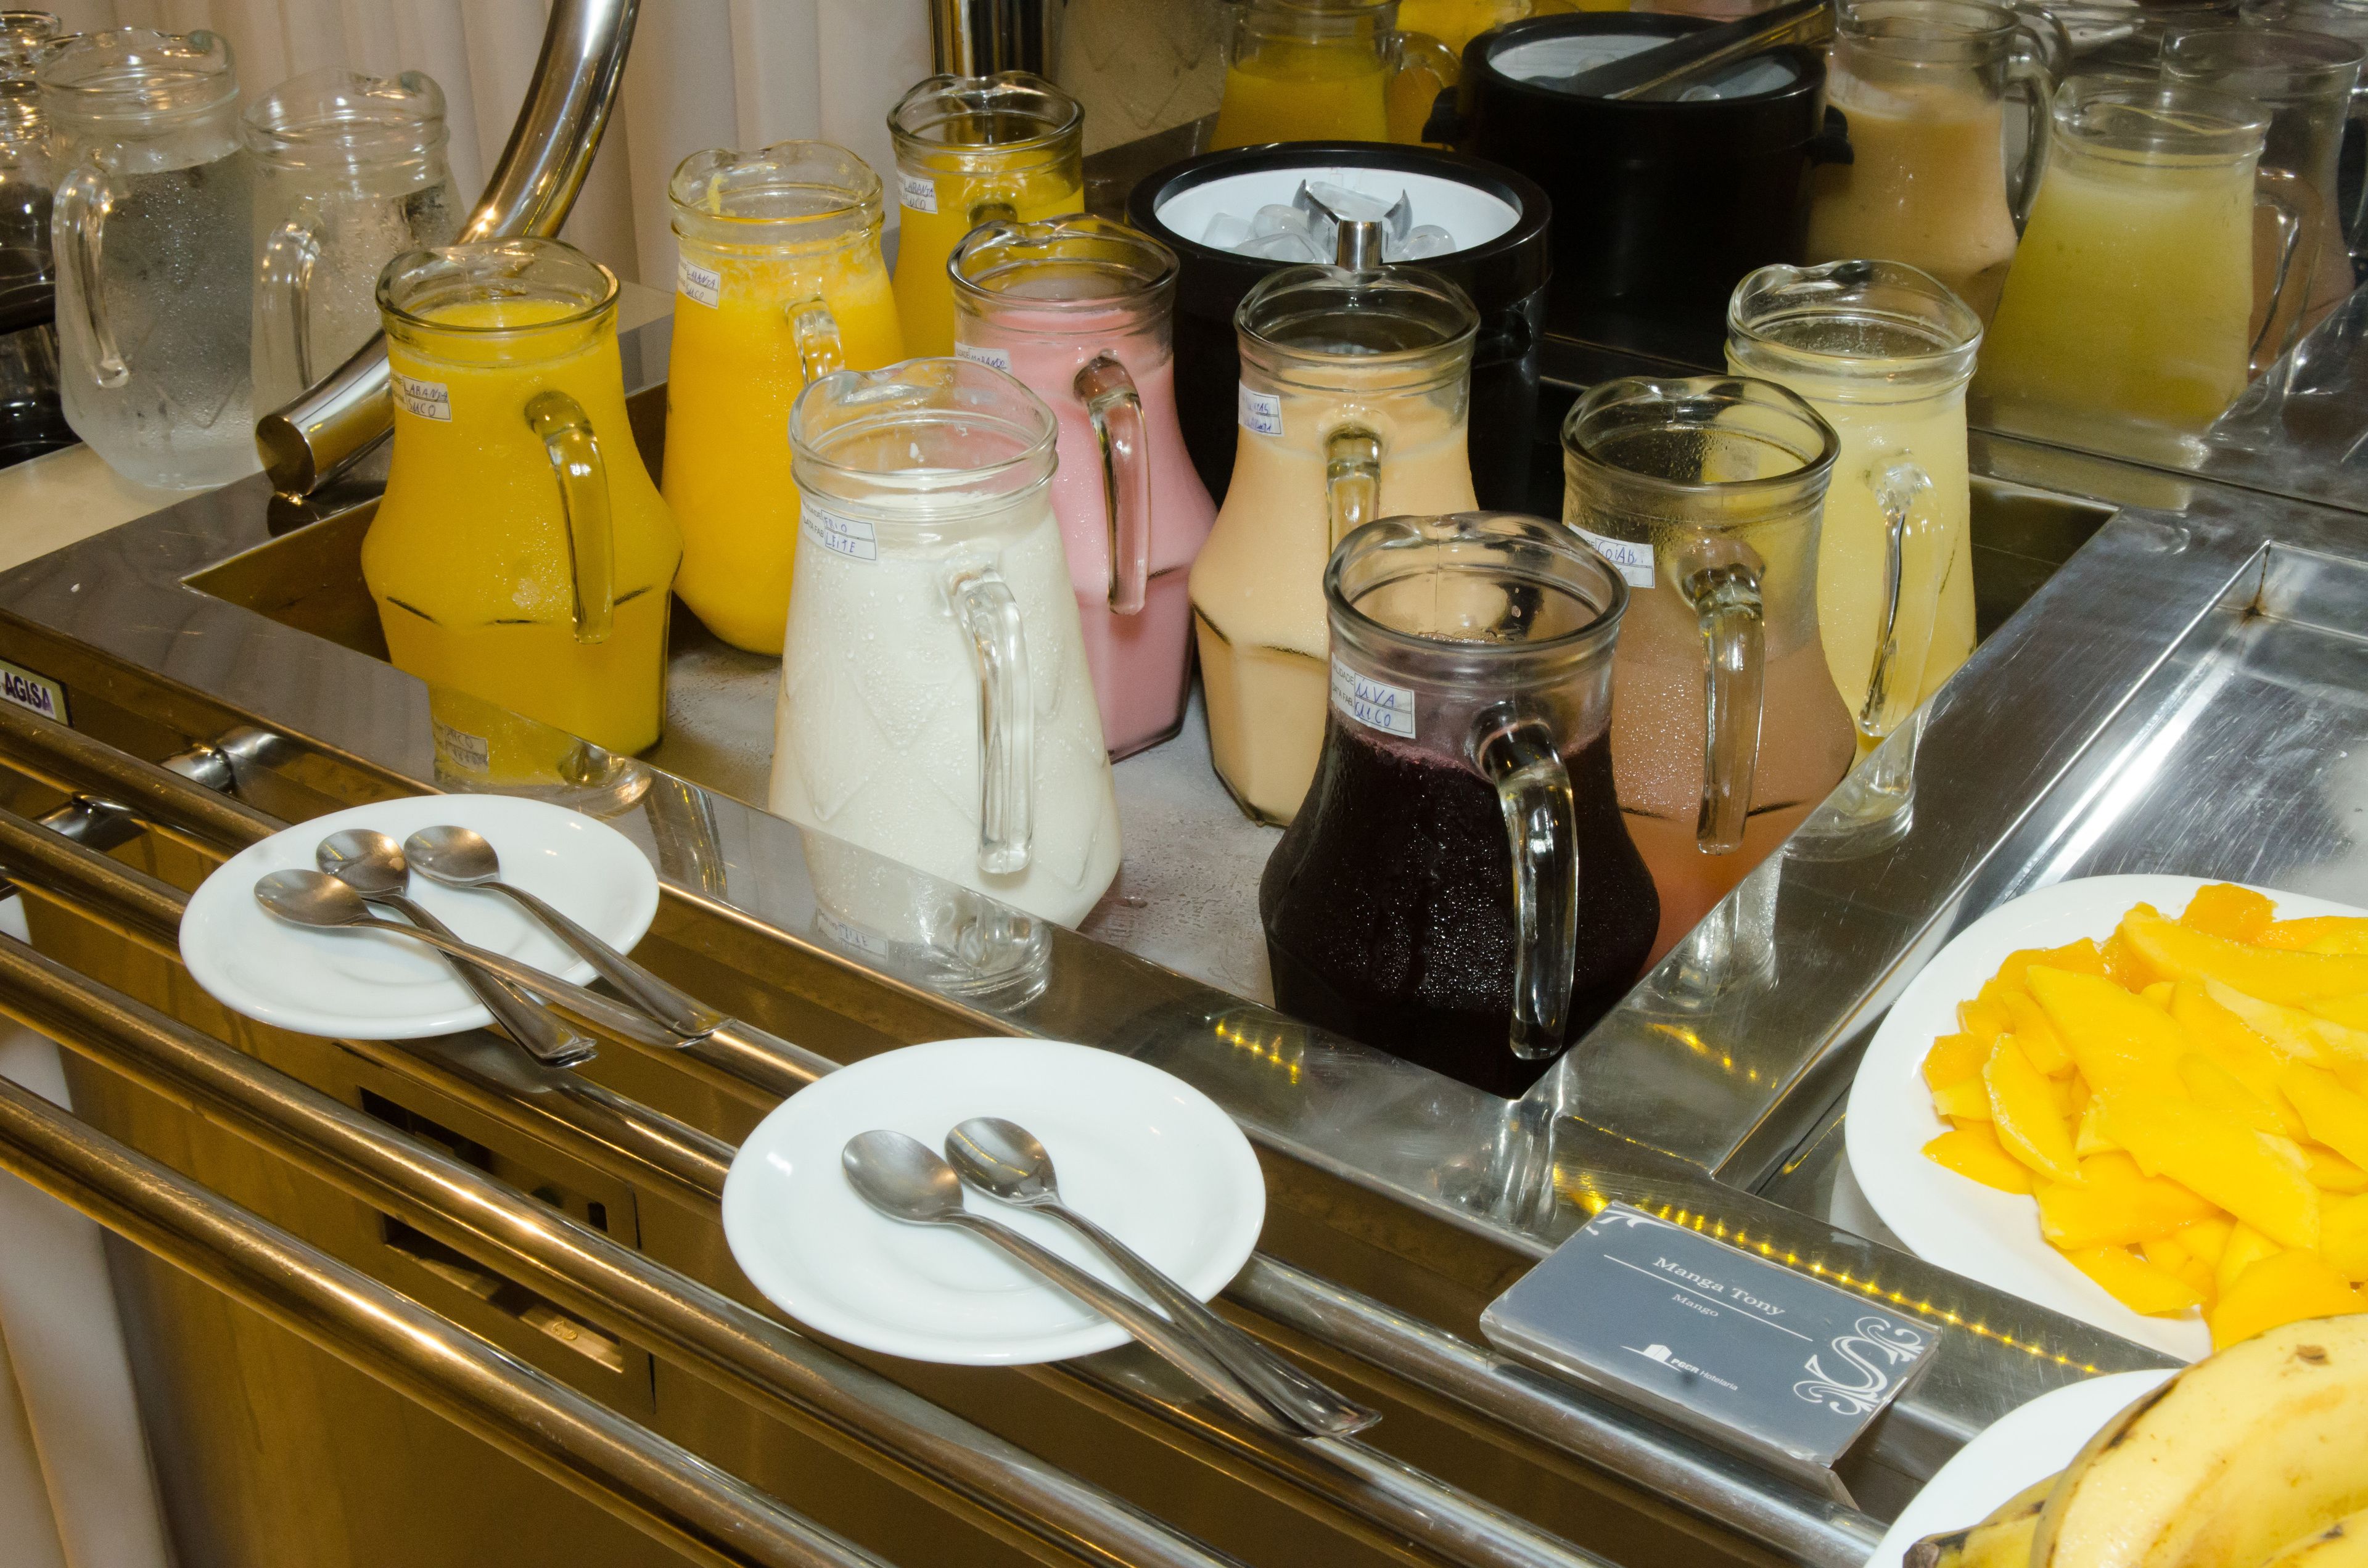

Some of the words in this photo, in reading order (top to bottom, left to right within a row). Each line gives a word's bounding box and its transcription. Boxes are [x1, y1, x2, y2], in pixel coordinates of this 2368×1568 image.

[826, 532, 856, 553] LEITE
[5, 671, 54, 715] AGISA
[1653, 1257, 1724, 1293] Manga
[1730, 1287, 1785, 1315] Tony
[1671, 1294, 1719, 1316] Mango
[1700, 1370, 1738, 1391] Hotelaria
